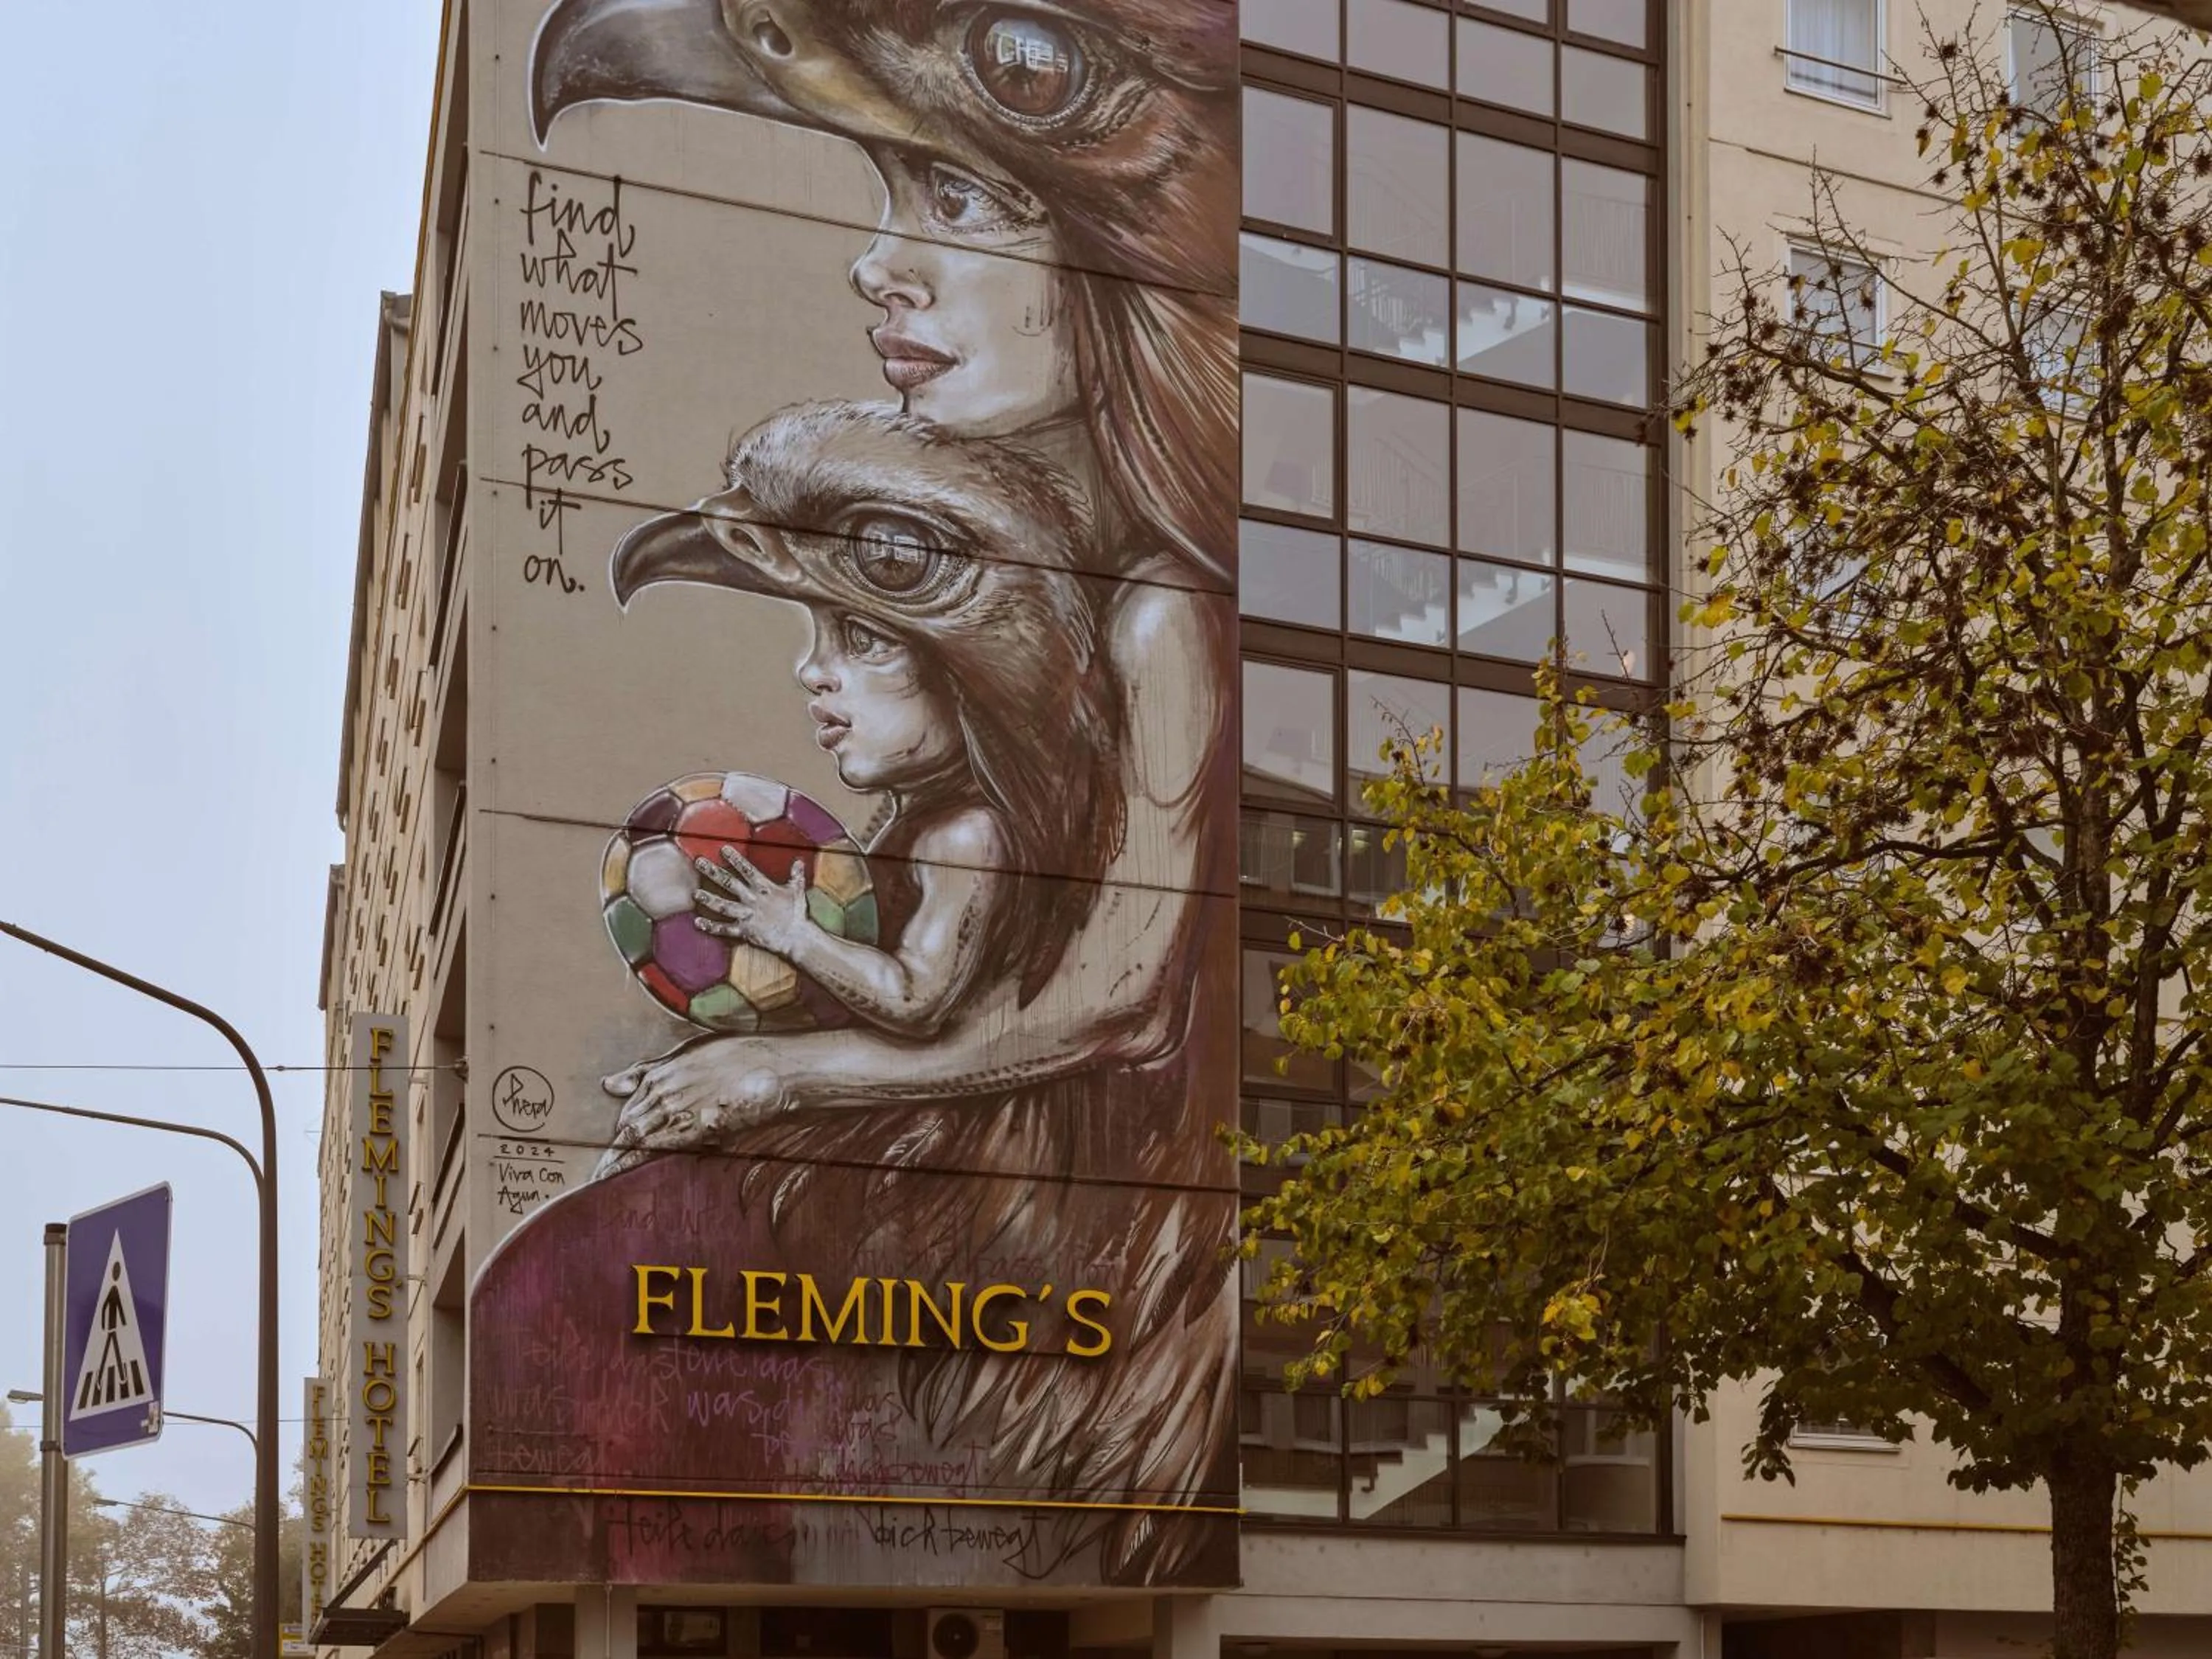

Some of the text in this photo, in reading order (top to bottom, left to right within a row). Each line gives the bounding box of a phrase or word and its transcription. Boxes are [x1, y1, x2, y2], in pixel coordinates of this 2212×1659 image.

[520, 170, 635, 258] find
[520, 228, 638, 322] what
[521, 300, 643, 355] moves
[517, 344, 602, 399] you
[522, 394, 610, 453] and
[522, 444, 633, 510] pass
[539, 487, 582, 554] it
[524, 554, 585, 594] on.
[499, 1162, 566, 1184] Viva Con
[500, 1144, 554, 1156] 2024
[632, 1264, 1113, 1357] FLEMING'S
[362, 1341, 396, 1523] HOTEL
